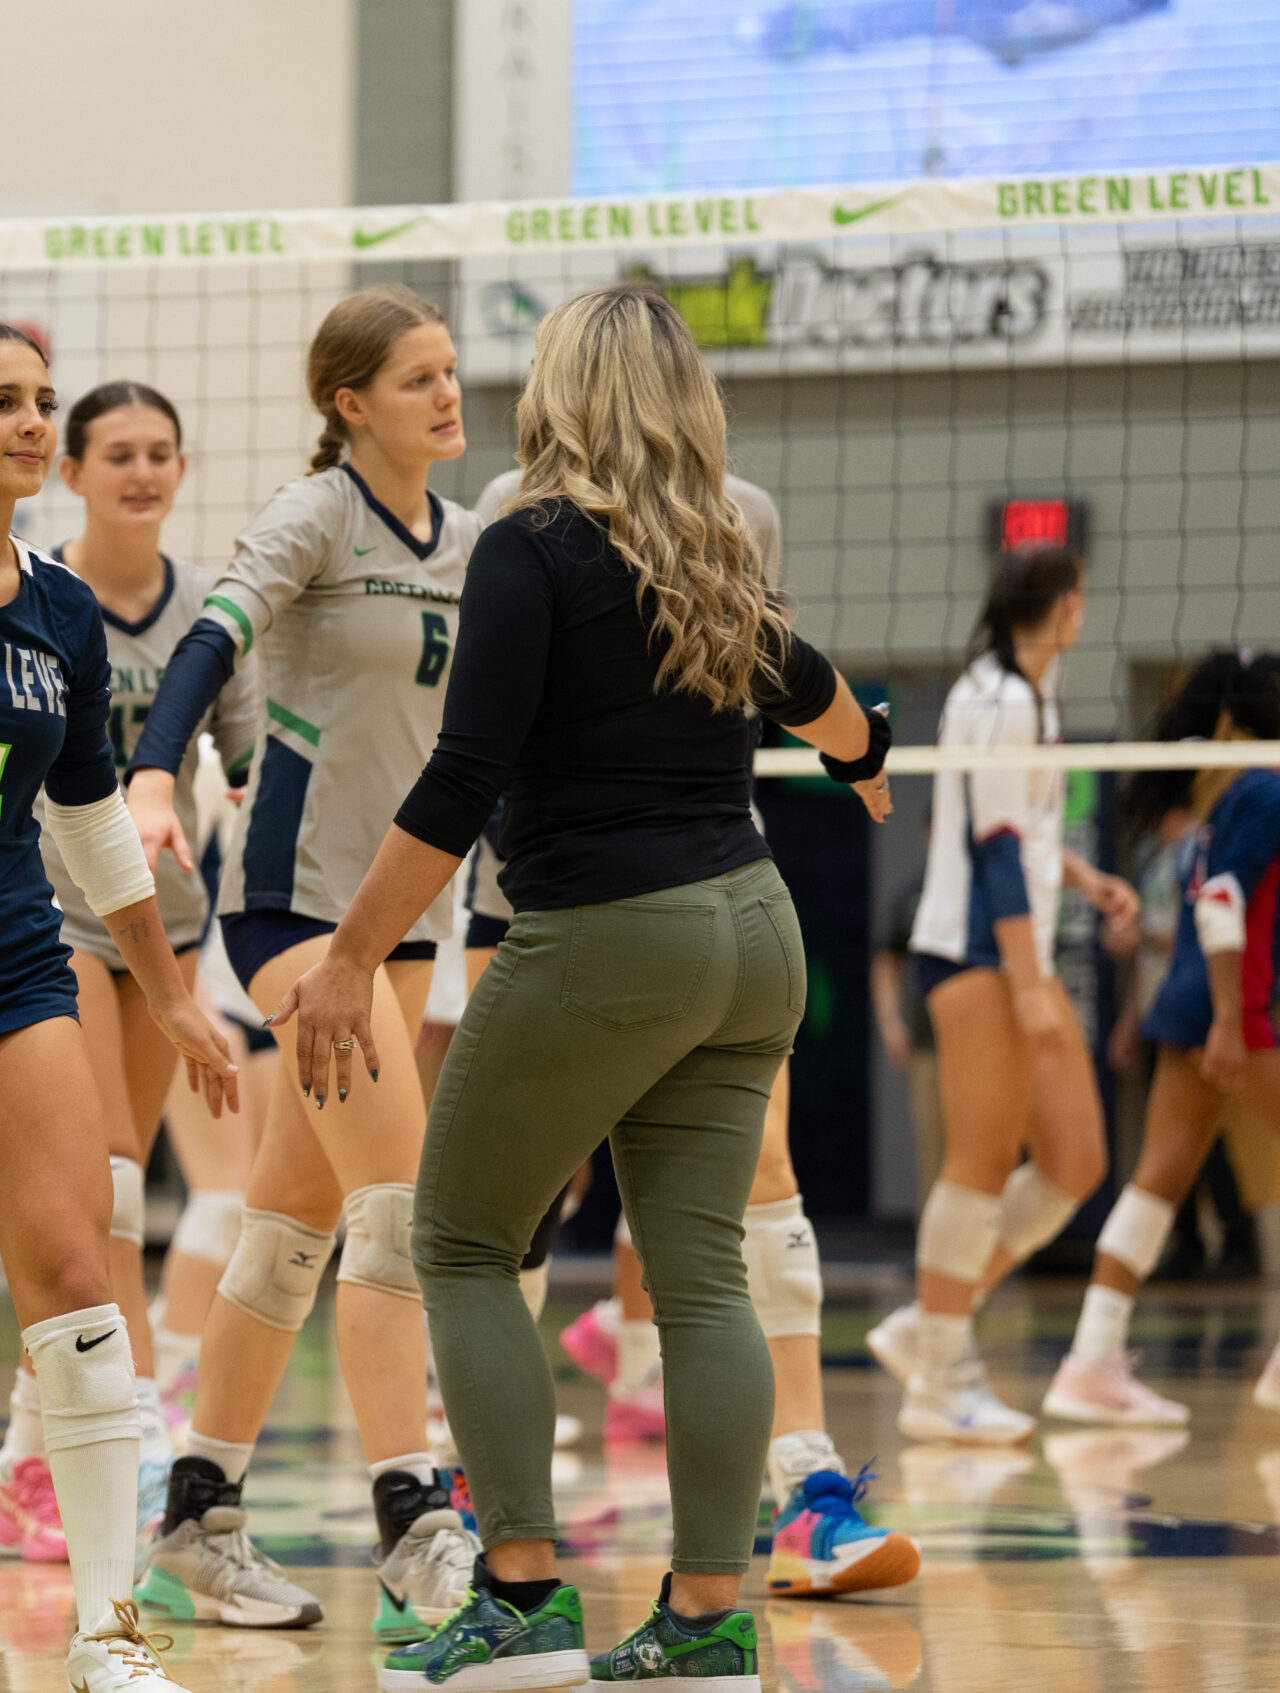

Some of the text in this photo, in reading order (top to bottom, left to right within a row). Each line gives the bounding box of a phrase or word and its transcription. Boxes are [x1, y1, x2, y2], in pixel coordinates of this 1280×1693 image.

[997, 168, 1269, 218] GREEN LEVEL
[44, 218, 284, 259] GREEN LEVEL
[506, 196, 760, 244] GREEN LEVEL
[414, 609, 450, 688] 6
[4, 642, 68, 717] LEVE
